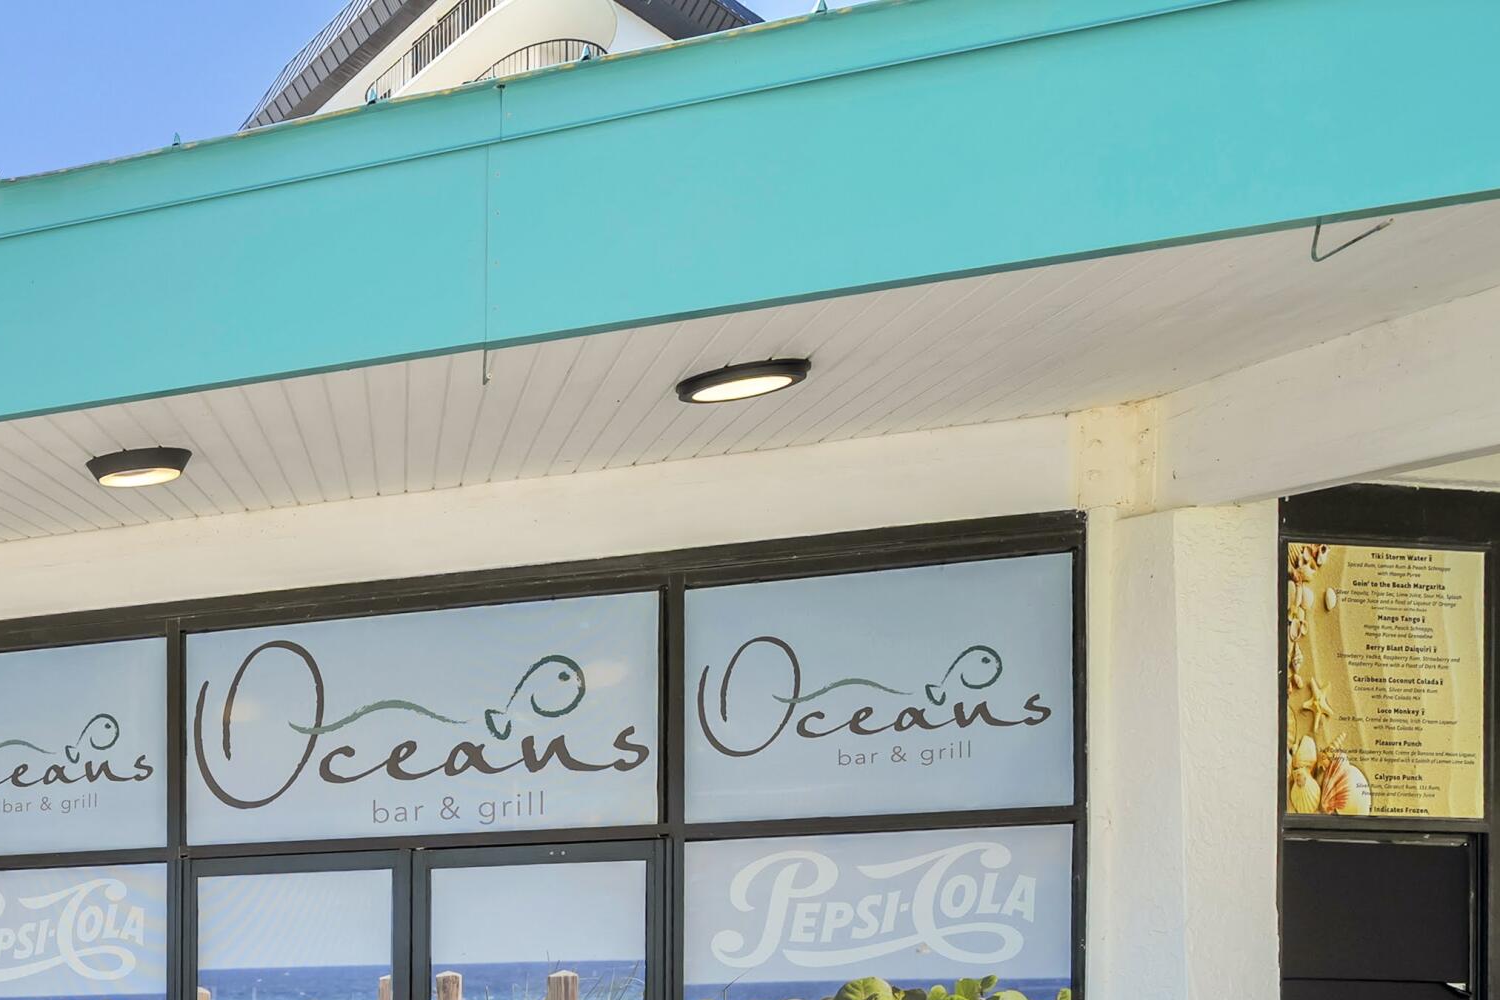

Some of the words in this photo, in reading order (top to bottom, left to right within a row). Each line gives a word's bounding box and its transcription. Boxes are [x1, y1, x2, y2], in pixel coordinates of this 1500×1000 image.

[1401, 615, 1420, 623] Tango
[1366, 644, 1384, 652] Berry
[1353, 675, 1386, 683] Caribbean
[698, 636, 1051, 757] Oceans
[1394, 708, 1419, 716] Monkey
[194, 640, 650, 810] Oceans
[1375, 739, 1401, 747] Pleasure
[838, 749, 878, 766] bar
[890, 746, 907, 763] &
[920, 740, 971, 766] grill
[1375, 774, 1400, 782] Calypso
[3, 799, 30, 813] bar
[40, 797, 52, 811] &
[61, 793, 97, 813] grill
[372, 800, 424, 824] bar
[440, 796, 462, 820] &
[479, 791, 544, 824] grill
